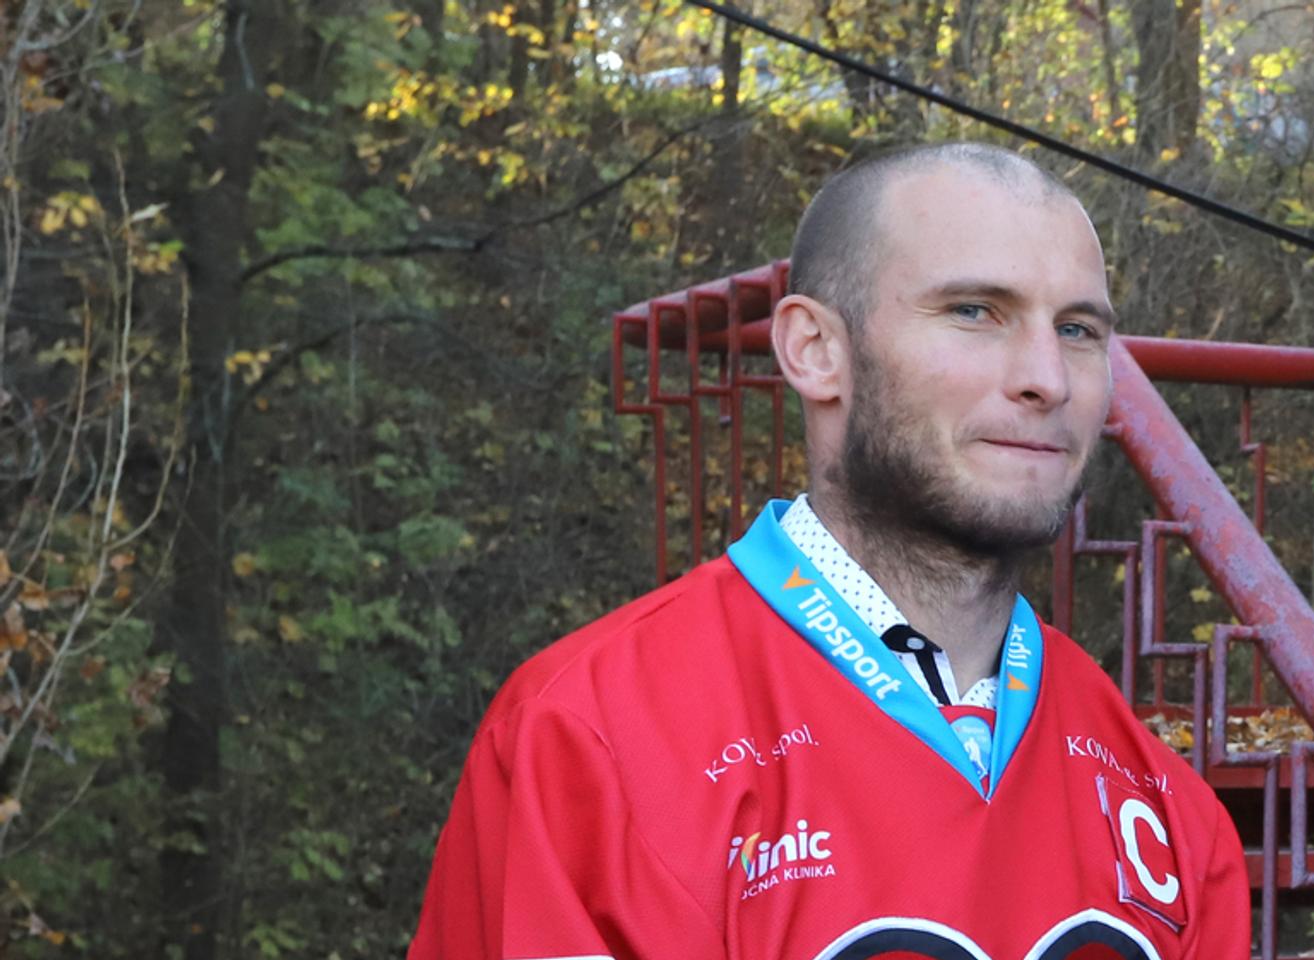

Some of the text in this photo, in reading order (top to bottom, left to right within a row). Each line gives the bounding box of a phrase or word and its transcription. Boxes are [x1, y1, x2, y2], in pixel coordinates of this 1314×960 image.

[797, 587, 902, 700] Tipsport
[1065, 735, 1121, 774] KOVA
[783, 864, 836, 881] KLINIKA
[1119, 798, 1180, 904] C
